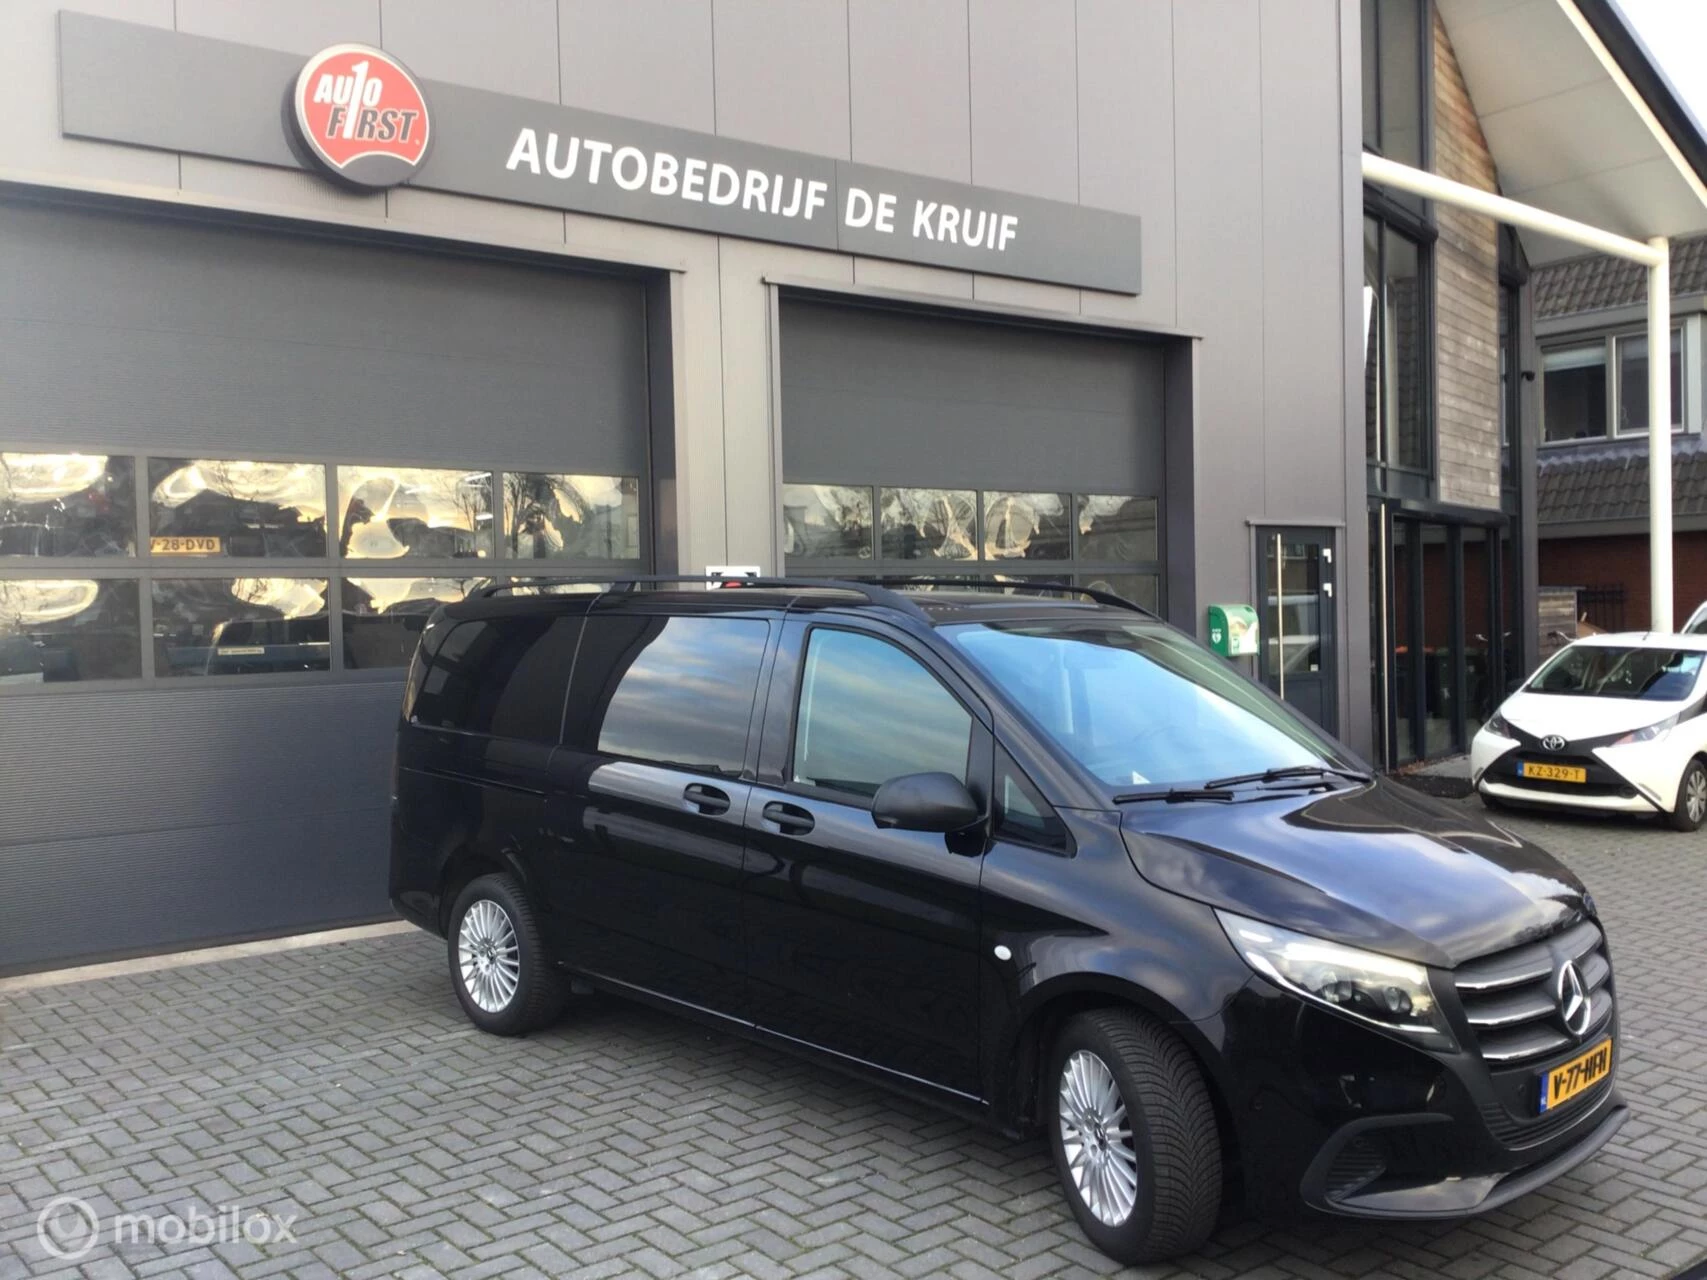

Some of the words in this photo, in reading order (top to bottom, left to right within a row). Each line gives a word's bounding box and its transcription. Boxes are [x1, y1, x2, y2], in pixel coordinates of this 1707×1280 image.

[506, 127, 828, 220] AUTOBEDRIJF
[844, 187, 897, 233] DE
[912, 199, 1018, 251] KRUIF
[1527, 764, 1581, 780] KZ-329-T
